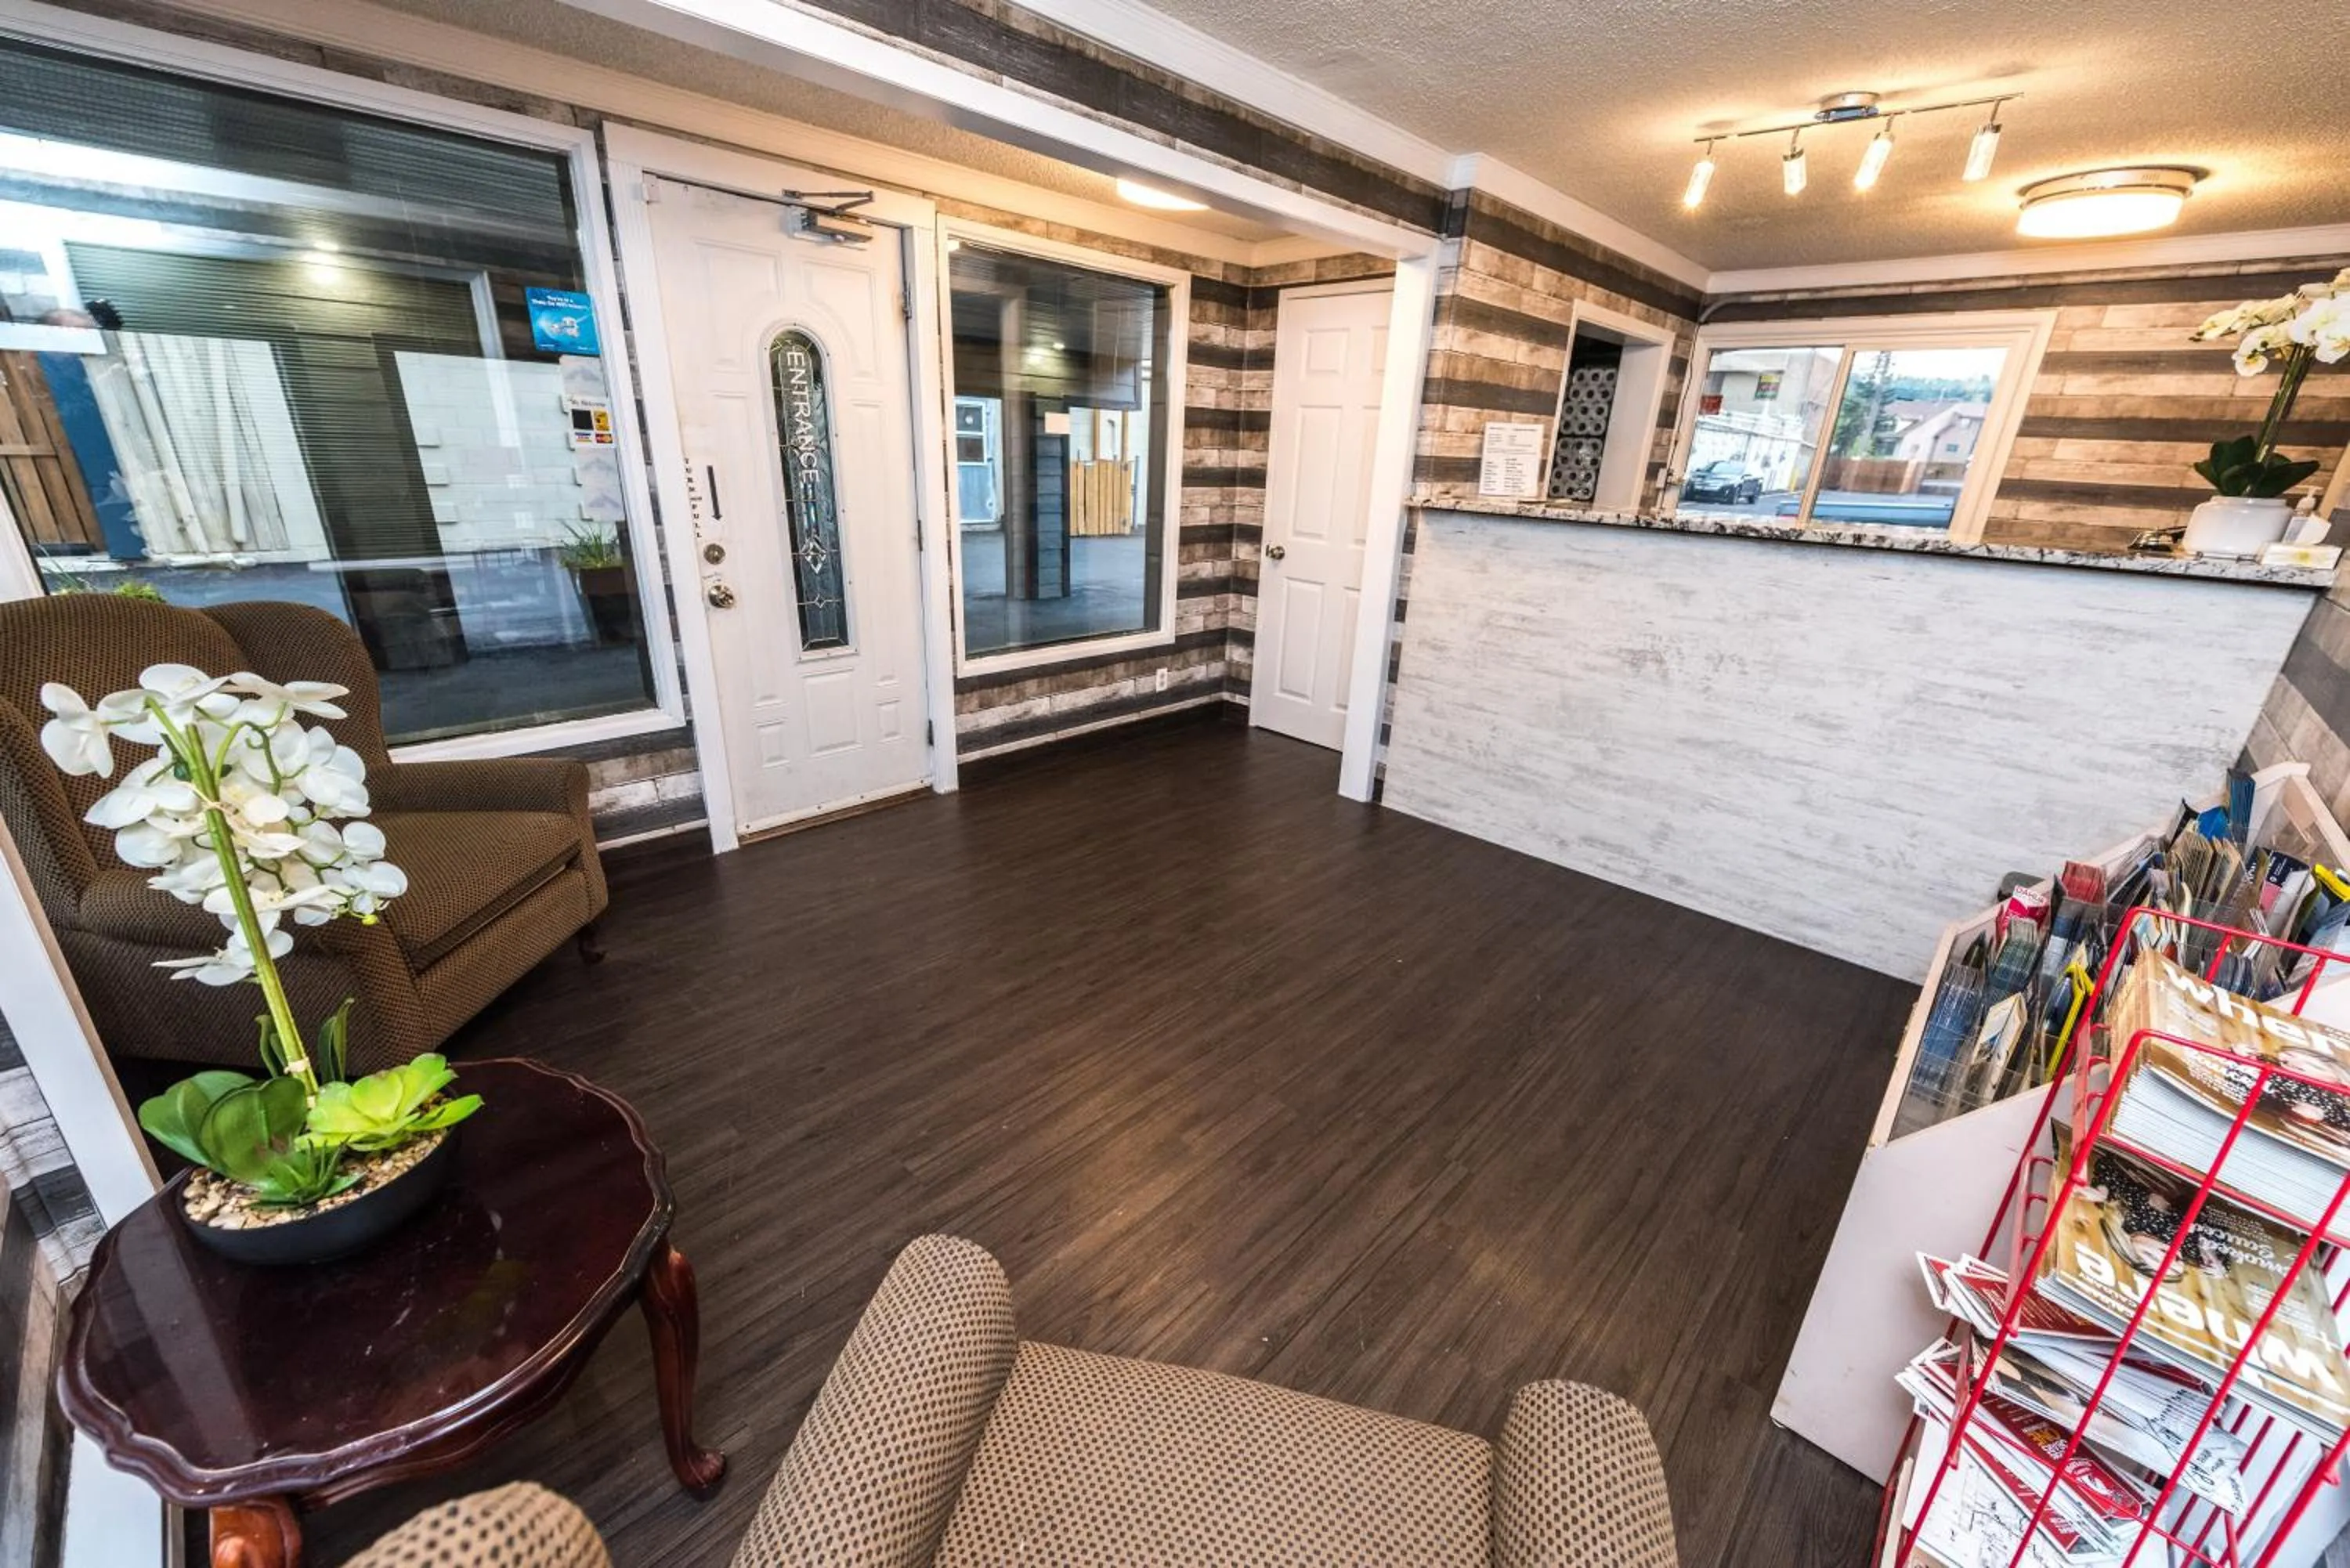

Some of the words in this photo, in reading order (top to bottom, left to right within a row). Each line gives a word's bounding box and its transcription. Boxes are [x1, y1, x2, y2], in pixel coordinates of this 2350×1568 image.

[786, 351, 819, 483] ENTRANCE
[692, 504, 703, 538] PULL
[2074, 1241, 2345, 1394] where
